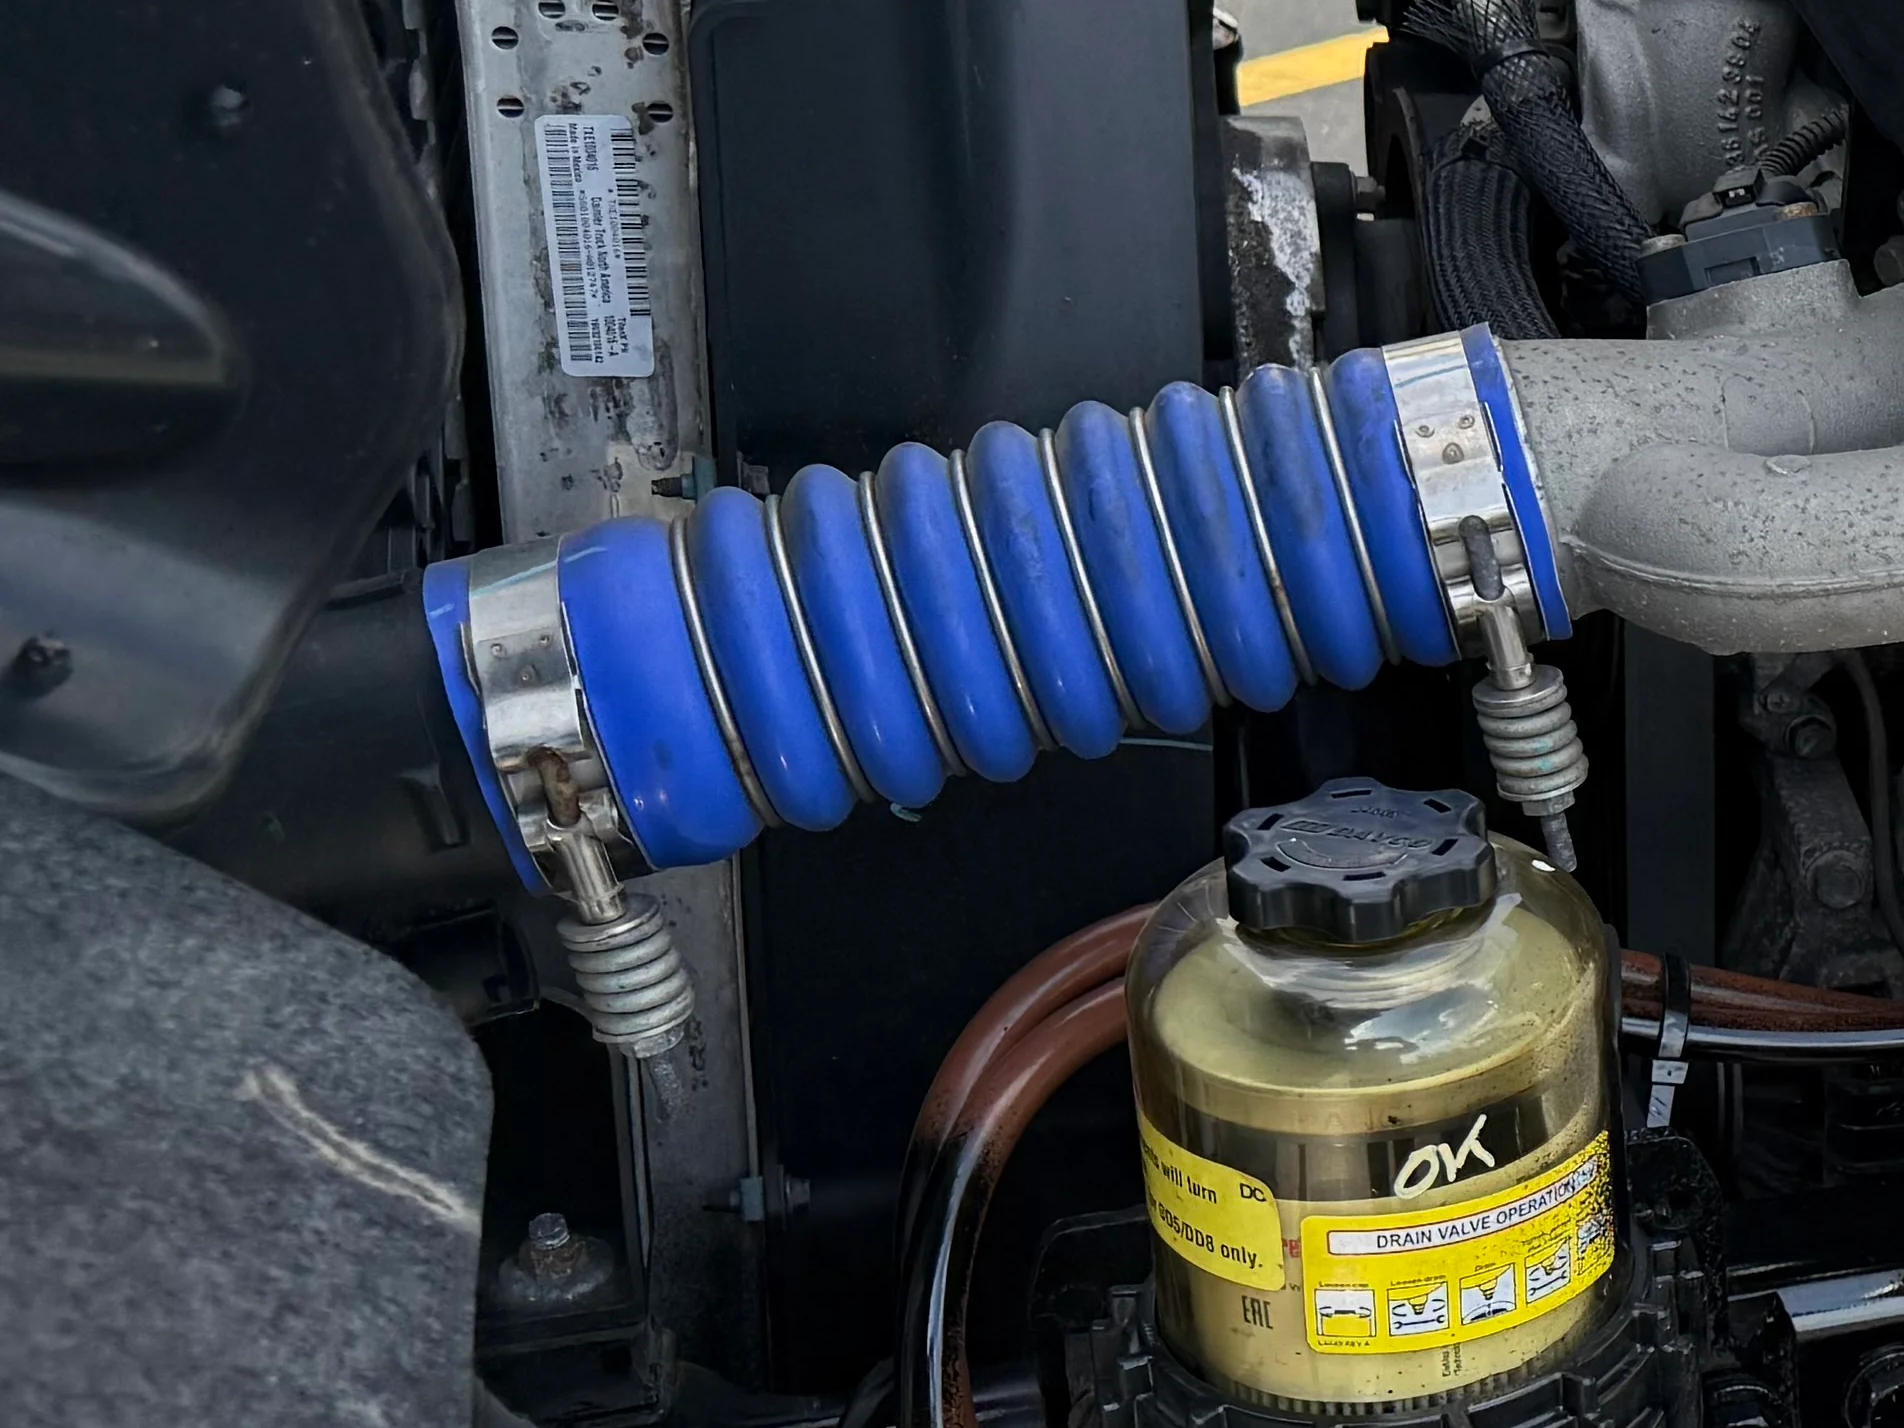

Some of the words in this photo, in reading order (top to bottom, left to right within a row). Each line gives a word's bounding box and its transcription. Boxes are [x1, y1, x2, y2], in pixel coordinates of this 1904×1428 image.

[1393, 1113, 1496, 1200] OK
[1161, 1161, 1183, 1188] will
[1186, 1175, 1217, 1204] turn
[1240, 1182, 1267, 1203] DC
[1376, 1230, 1433, 1250] DRAIN
[1438, 1215, 1492, 1241] VALVE
[1221, 1243, 1264, 1270] only.
